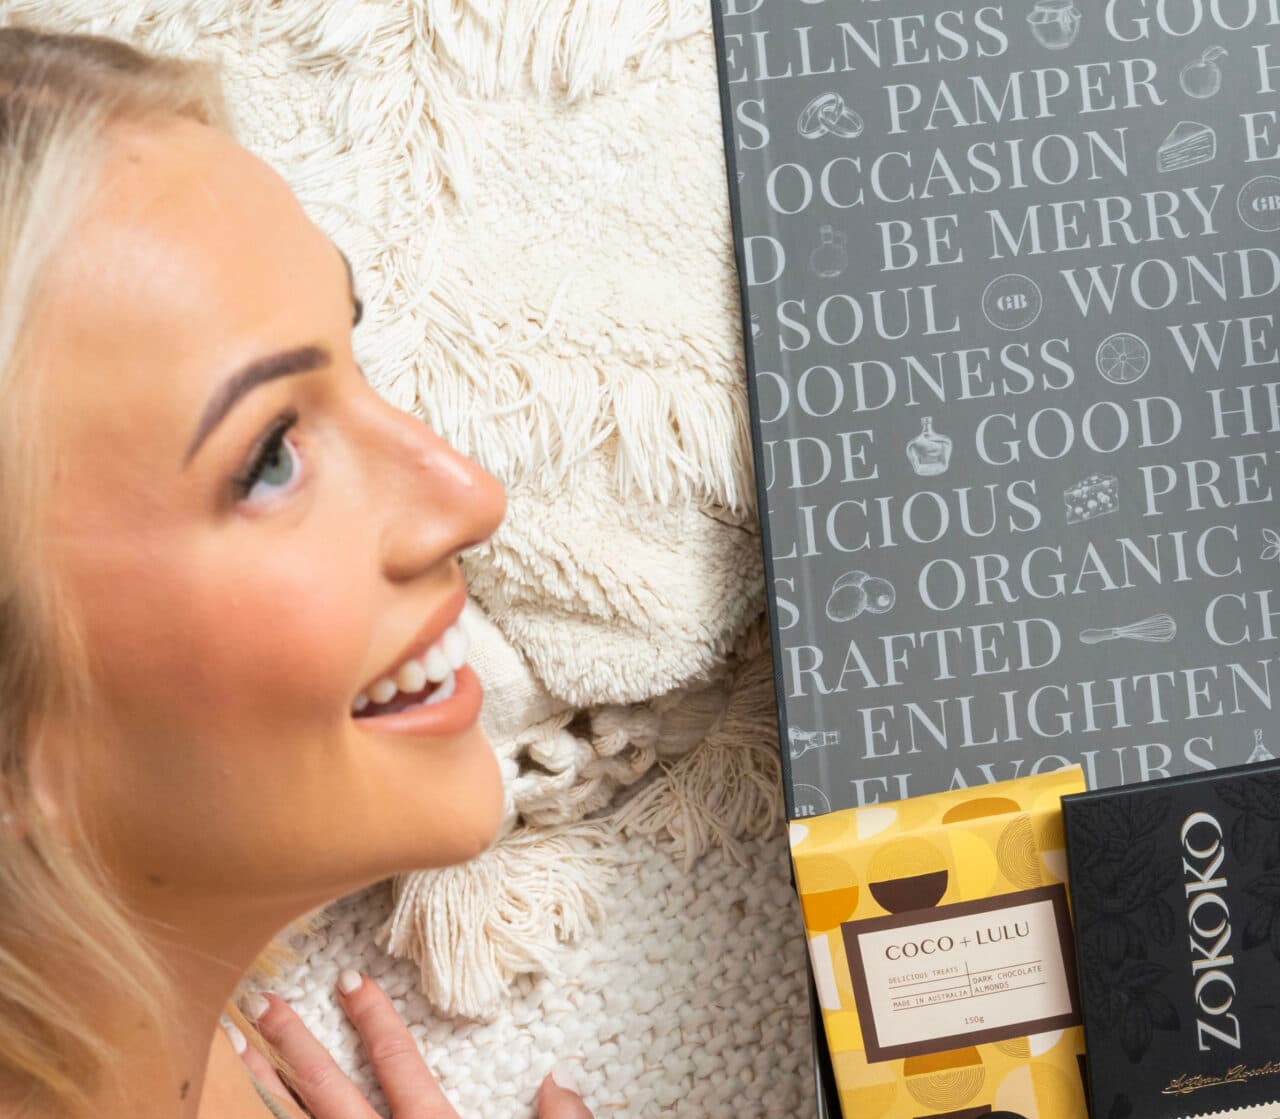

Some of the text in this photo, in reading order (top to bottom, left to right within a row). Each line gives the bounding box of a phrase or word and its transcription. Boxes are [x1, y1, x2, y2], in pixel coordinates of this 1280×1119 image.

[736, 99, 770, 151] S
[883, 57, 1167, 135] PAMPER
[766, 127, 1129, 216] OCCASION
[743, 236, 786, 286] D
[875, 214, 964, 272] BE
[984, 184, 1224, 260] MERRY
[776, 284, 960, 352] SOUL
[975, 396, 1182, 467] GOOD
[918, 525, 1241, 611] ORGANIC
[785, 618, 1061, 698] RAFTED
[885, 936, 954, 960] COCO
[976, 921, 1030, 945] LULU
[1181, 811, 1242, 1051] ZOKOKO
[888, 966, 958, 984] DELICIOUS TREATS
[893, 990, 968, 1008] MADE IN AUSTRALIA
[973, 965, 1042, 984] DARK CHOCOLATE
[975, 981, 1009, 994] ALMONDS
[965, 1015, 985, 1025] 150g
